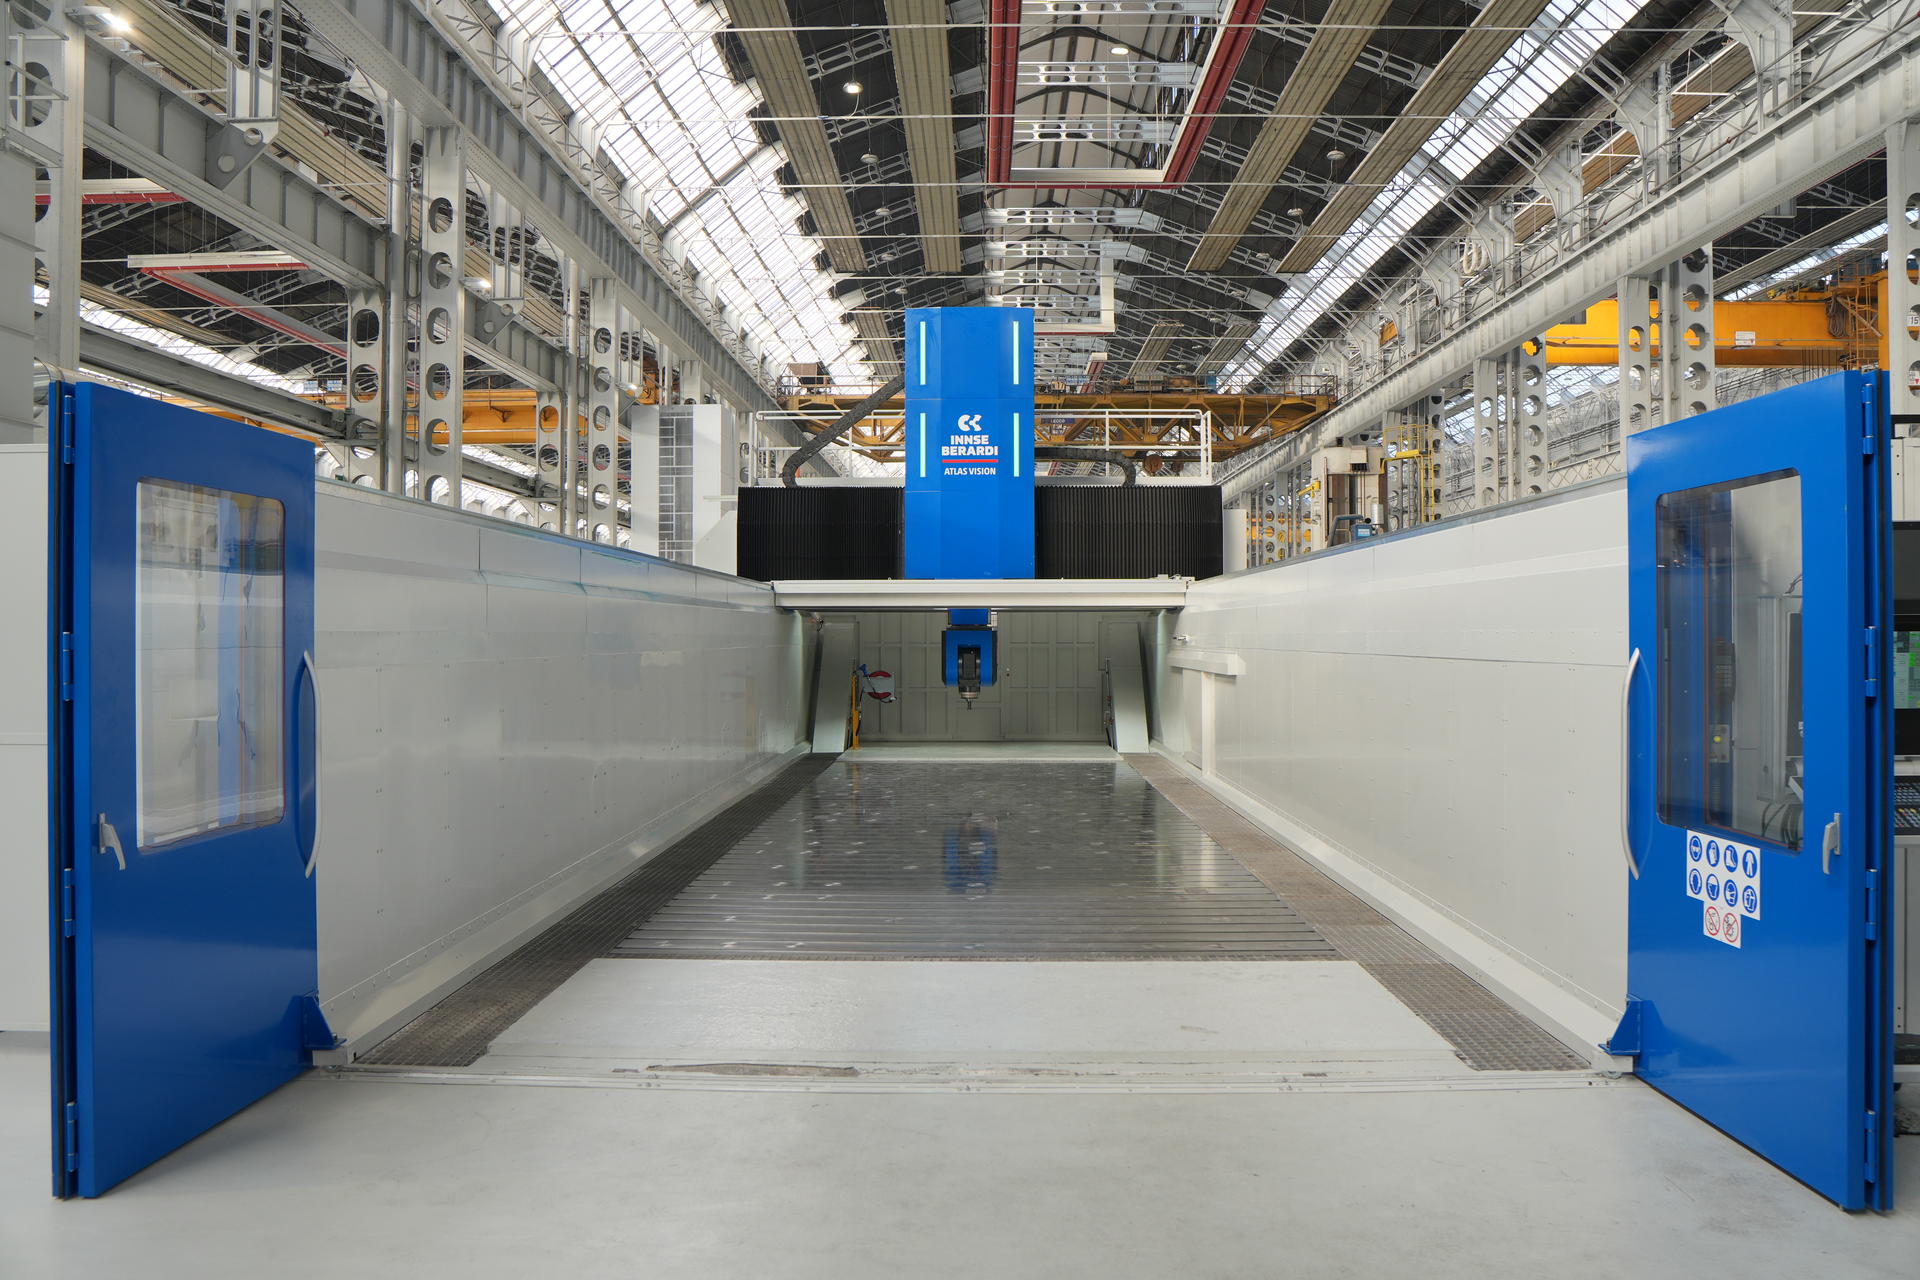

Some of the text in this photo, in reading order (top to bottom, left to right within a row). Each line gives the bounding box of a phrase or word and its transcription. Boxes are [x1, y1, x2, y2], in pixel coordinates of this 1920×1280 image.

[950, 435, 989, 445] INNSE
[941, 446, 999, 456] BERARDI
[944, 467, 996, 476] ATLAS VISION
